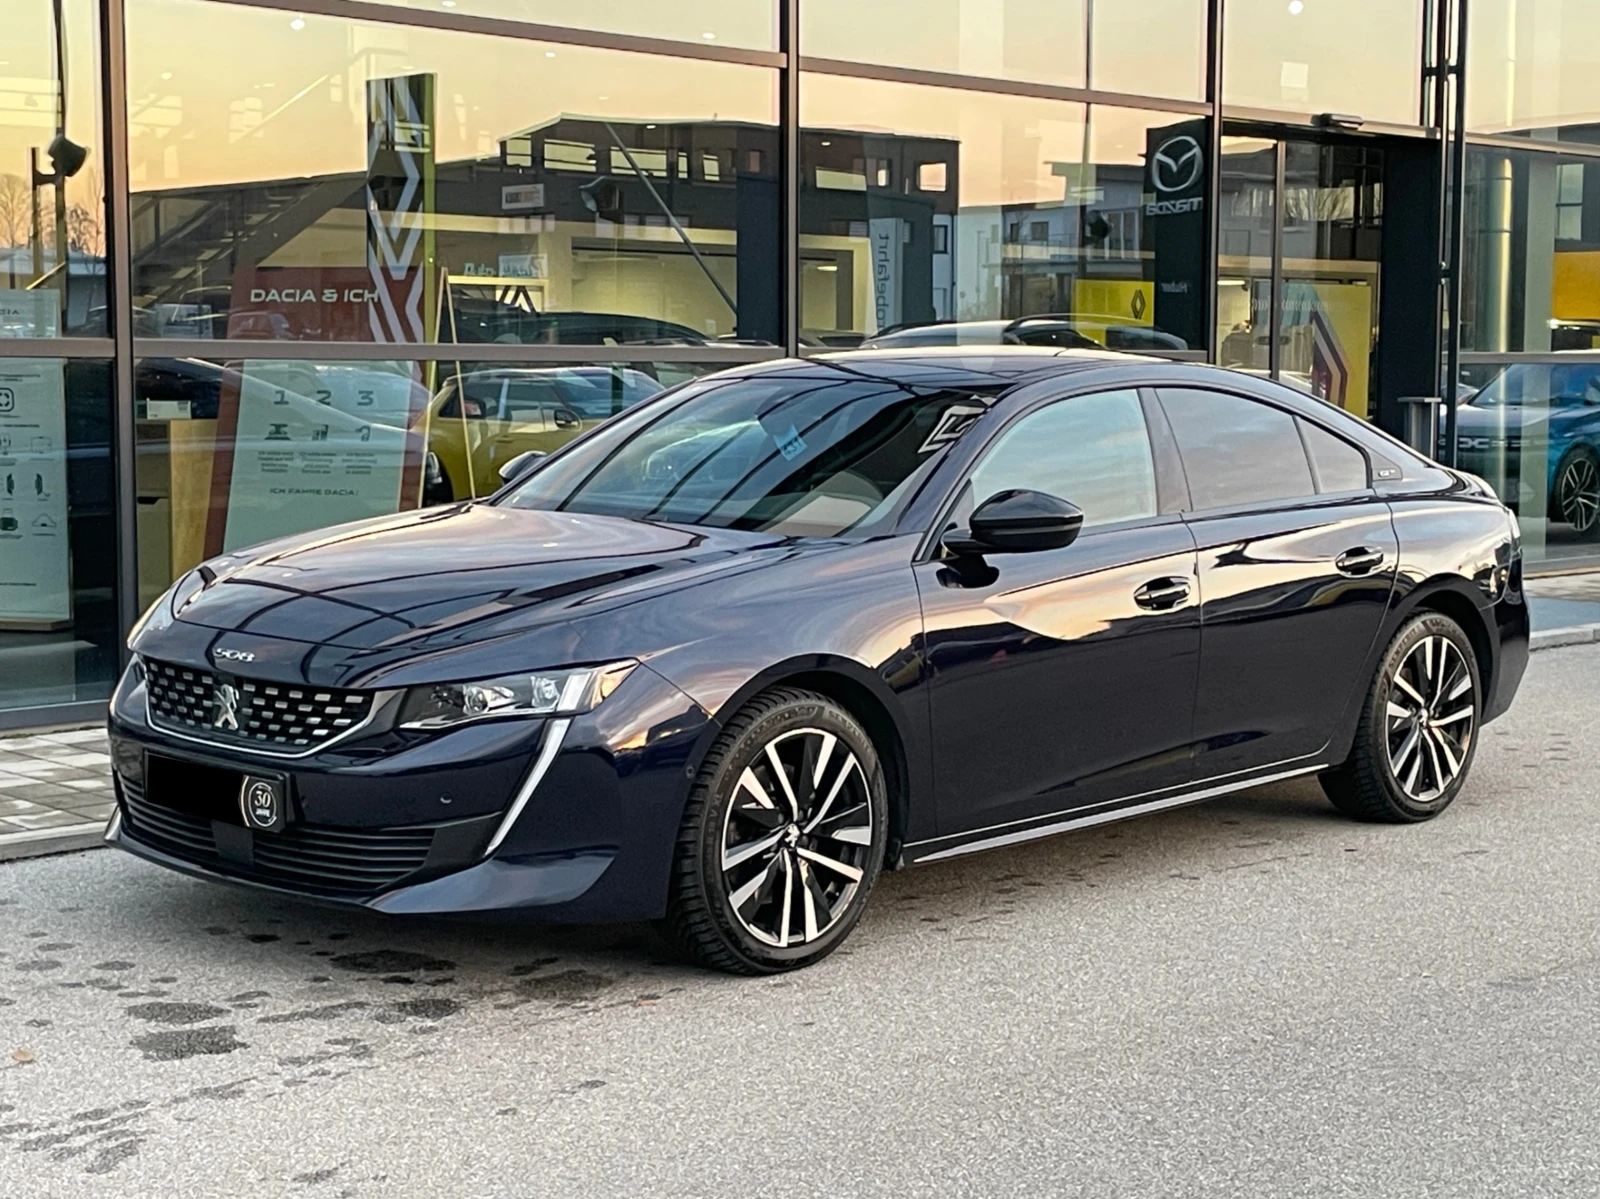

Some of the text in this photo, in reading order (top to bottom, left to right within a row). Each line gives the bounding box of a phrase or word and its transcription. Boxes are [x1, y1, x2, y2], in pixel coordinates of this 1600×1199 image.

[250, 288, 379, 303] DACIA & ICH
[273, 390, 374, 406] 1 2 3
[213, 648, 255, 662] 508
[254, 790, 271, 808] 30
